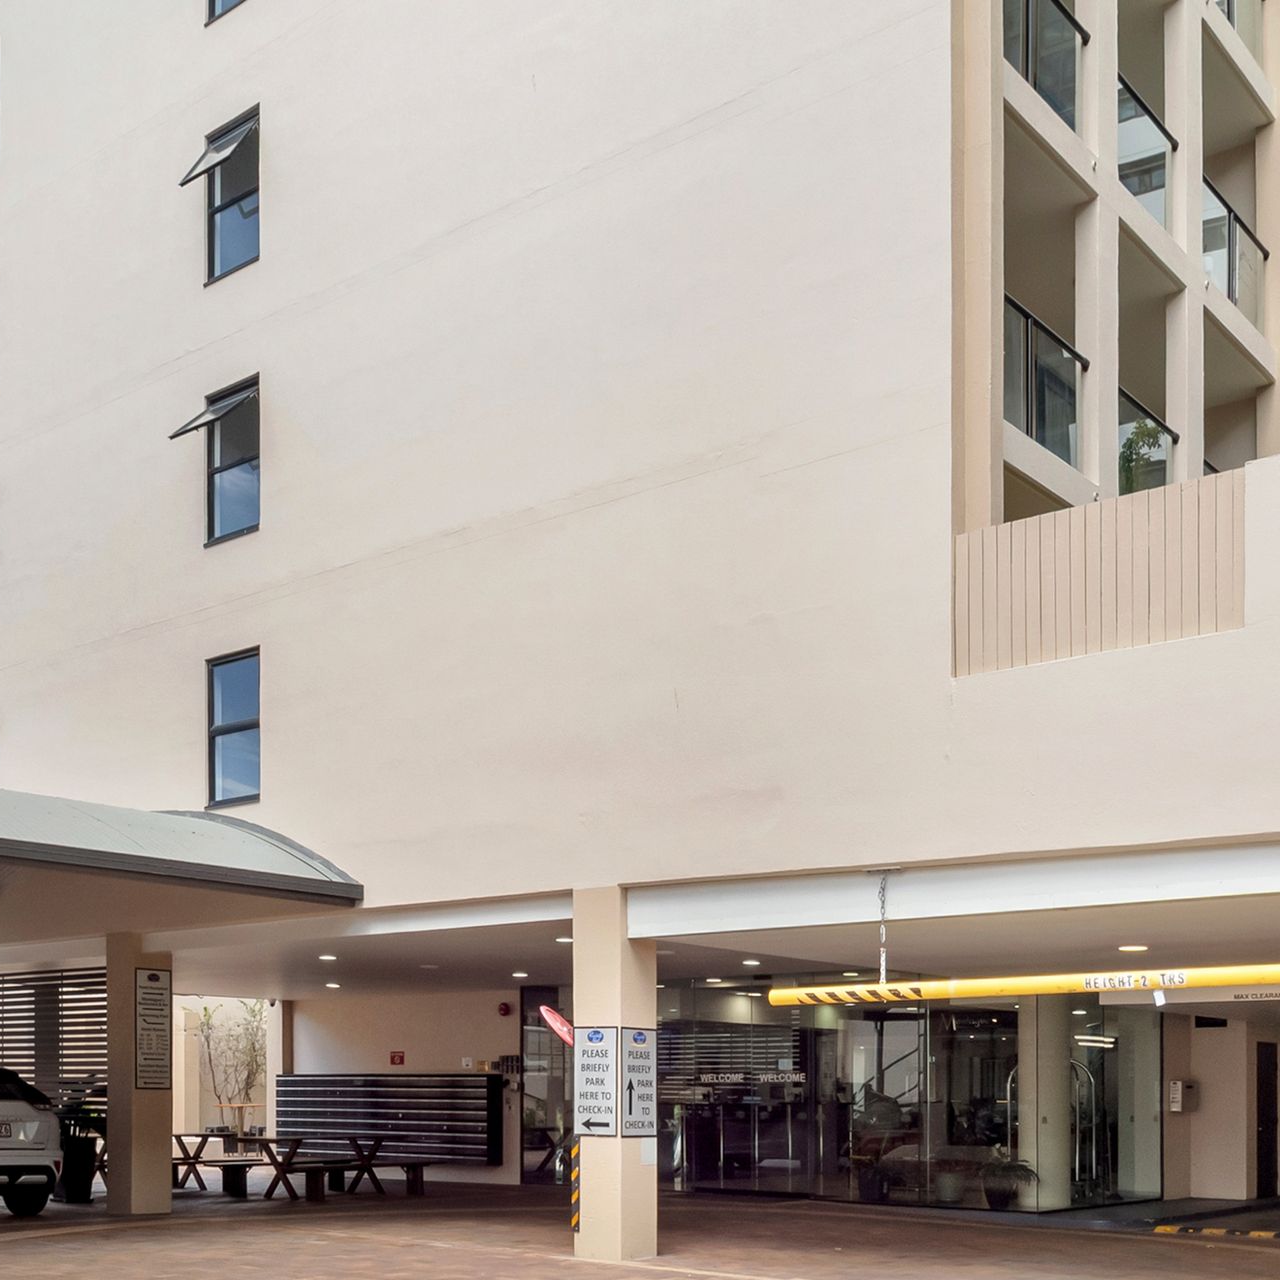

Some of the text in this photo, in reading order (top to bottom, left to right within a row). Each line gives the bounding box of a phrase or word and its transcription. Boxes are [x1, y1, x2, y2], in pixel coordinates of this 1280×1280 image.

[581, 1049, 609, 1058] PLEASE
[627, 1050, 651, 1060] PLEASE
[580, 1063, 610, 1072] BRIEFLY
[627, 1064, 652, 1074] BRIEFLY
[585, 1077, 606, 1086] PARK
[700, 1073, 744, 1083] WELCOME
[759, 1073, 807, 1083] WELCOME
[637, 1079, 654, 1088] PARK
[579, 1091, 612, 1101] HERE TO
[637, 1093, 654, 1102] HERE
[577, 1104, 613, 1114] CHECK-IN
[641, 1107, 650, 1116] TO
[624, 1120, 655, 1130] CHECK-IN
